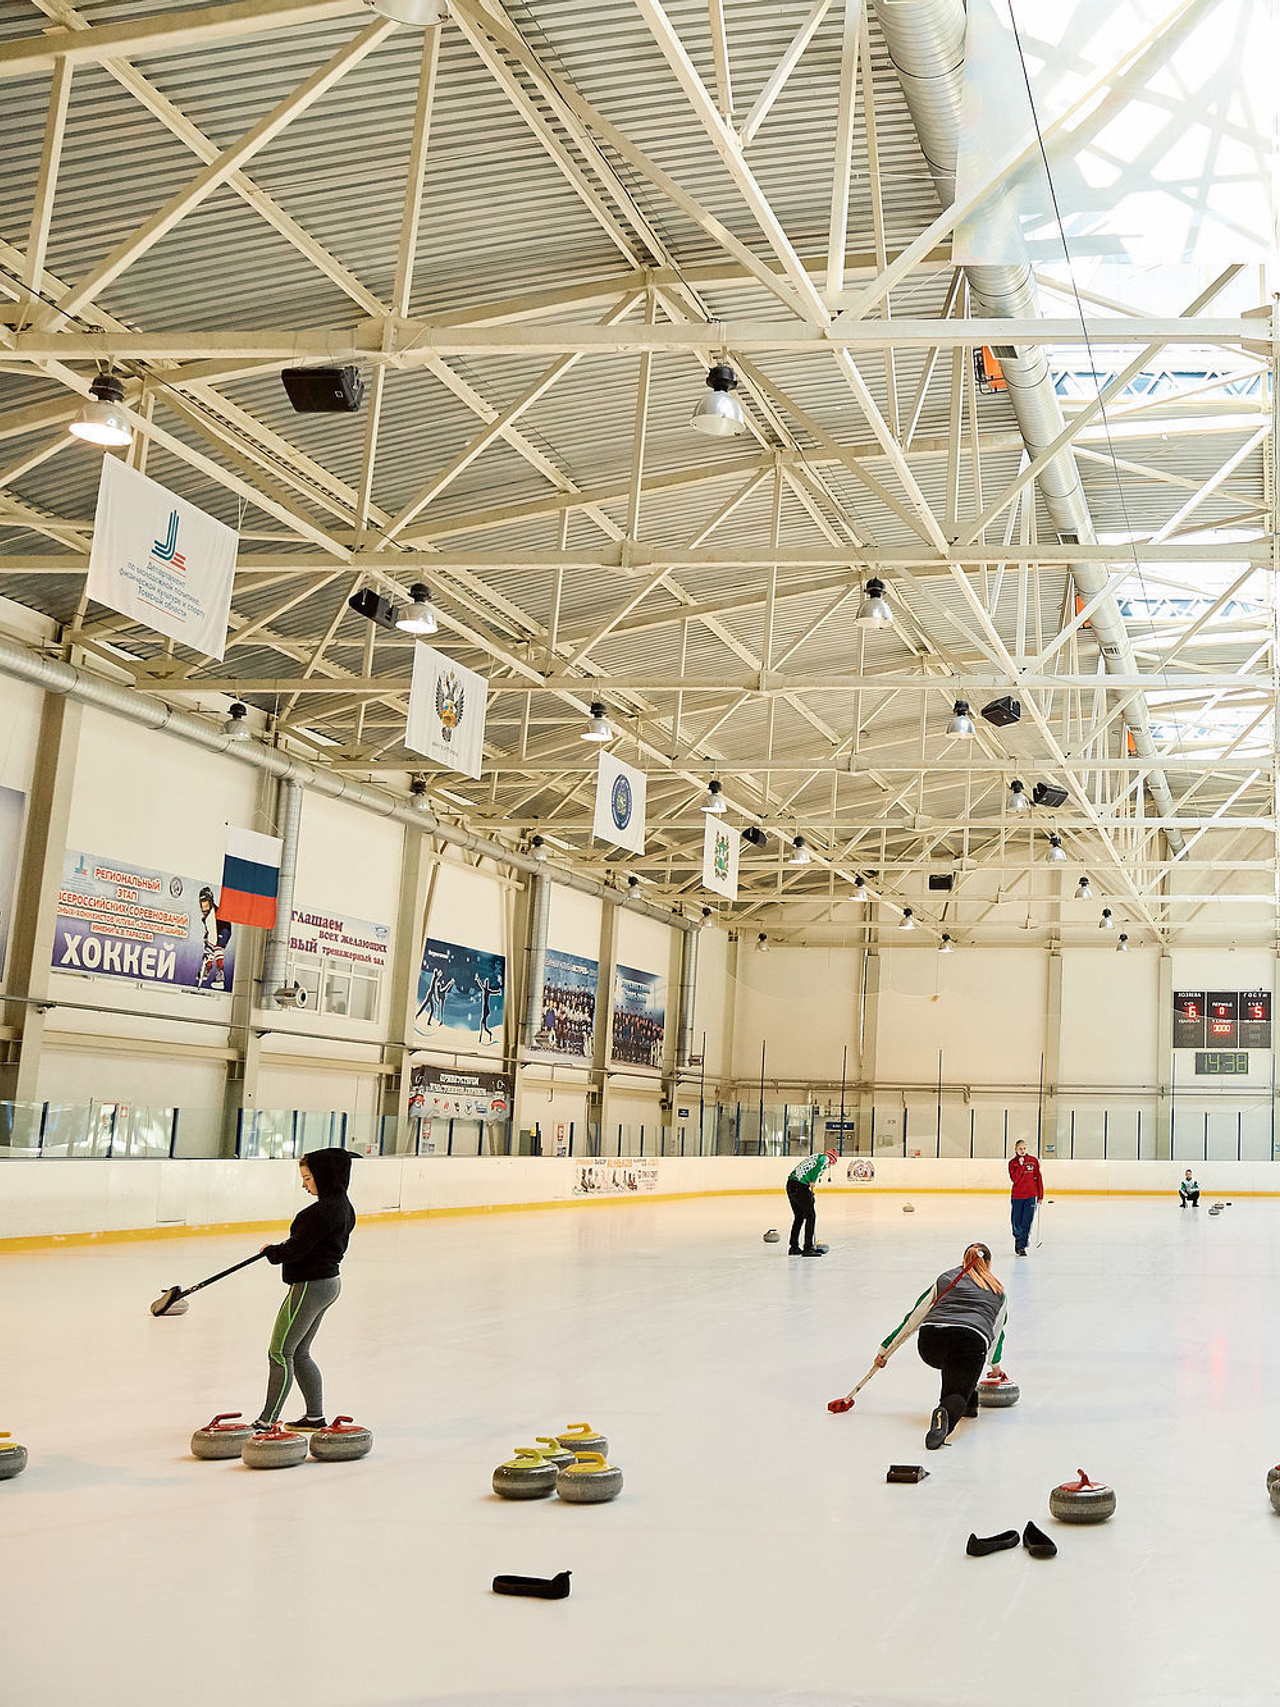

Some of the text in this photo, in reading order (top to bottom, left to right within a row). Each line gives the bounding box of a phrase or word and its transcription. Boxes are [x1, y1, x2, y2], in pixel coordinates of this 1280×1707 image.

[95, 868, 161, 891] РЕГИОНАЛЬНЫЙ
[117, 888, 138, 900] ЭТАП
[128, 903, 189, 926] СОРЕВНОВАНИЙ
[92, 923, 115, 934] ИМЕНИ
[61, 932, 176, 980] ХОККЕЙ
[1188, 1006, 1197, 1018] 6
[1254, 1006, 1263, 1018] 5
